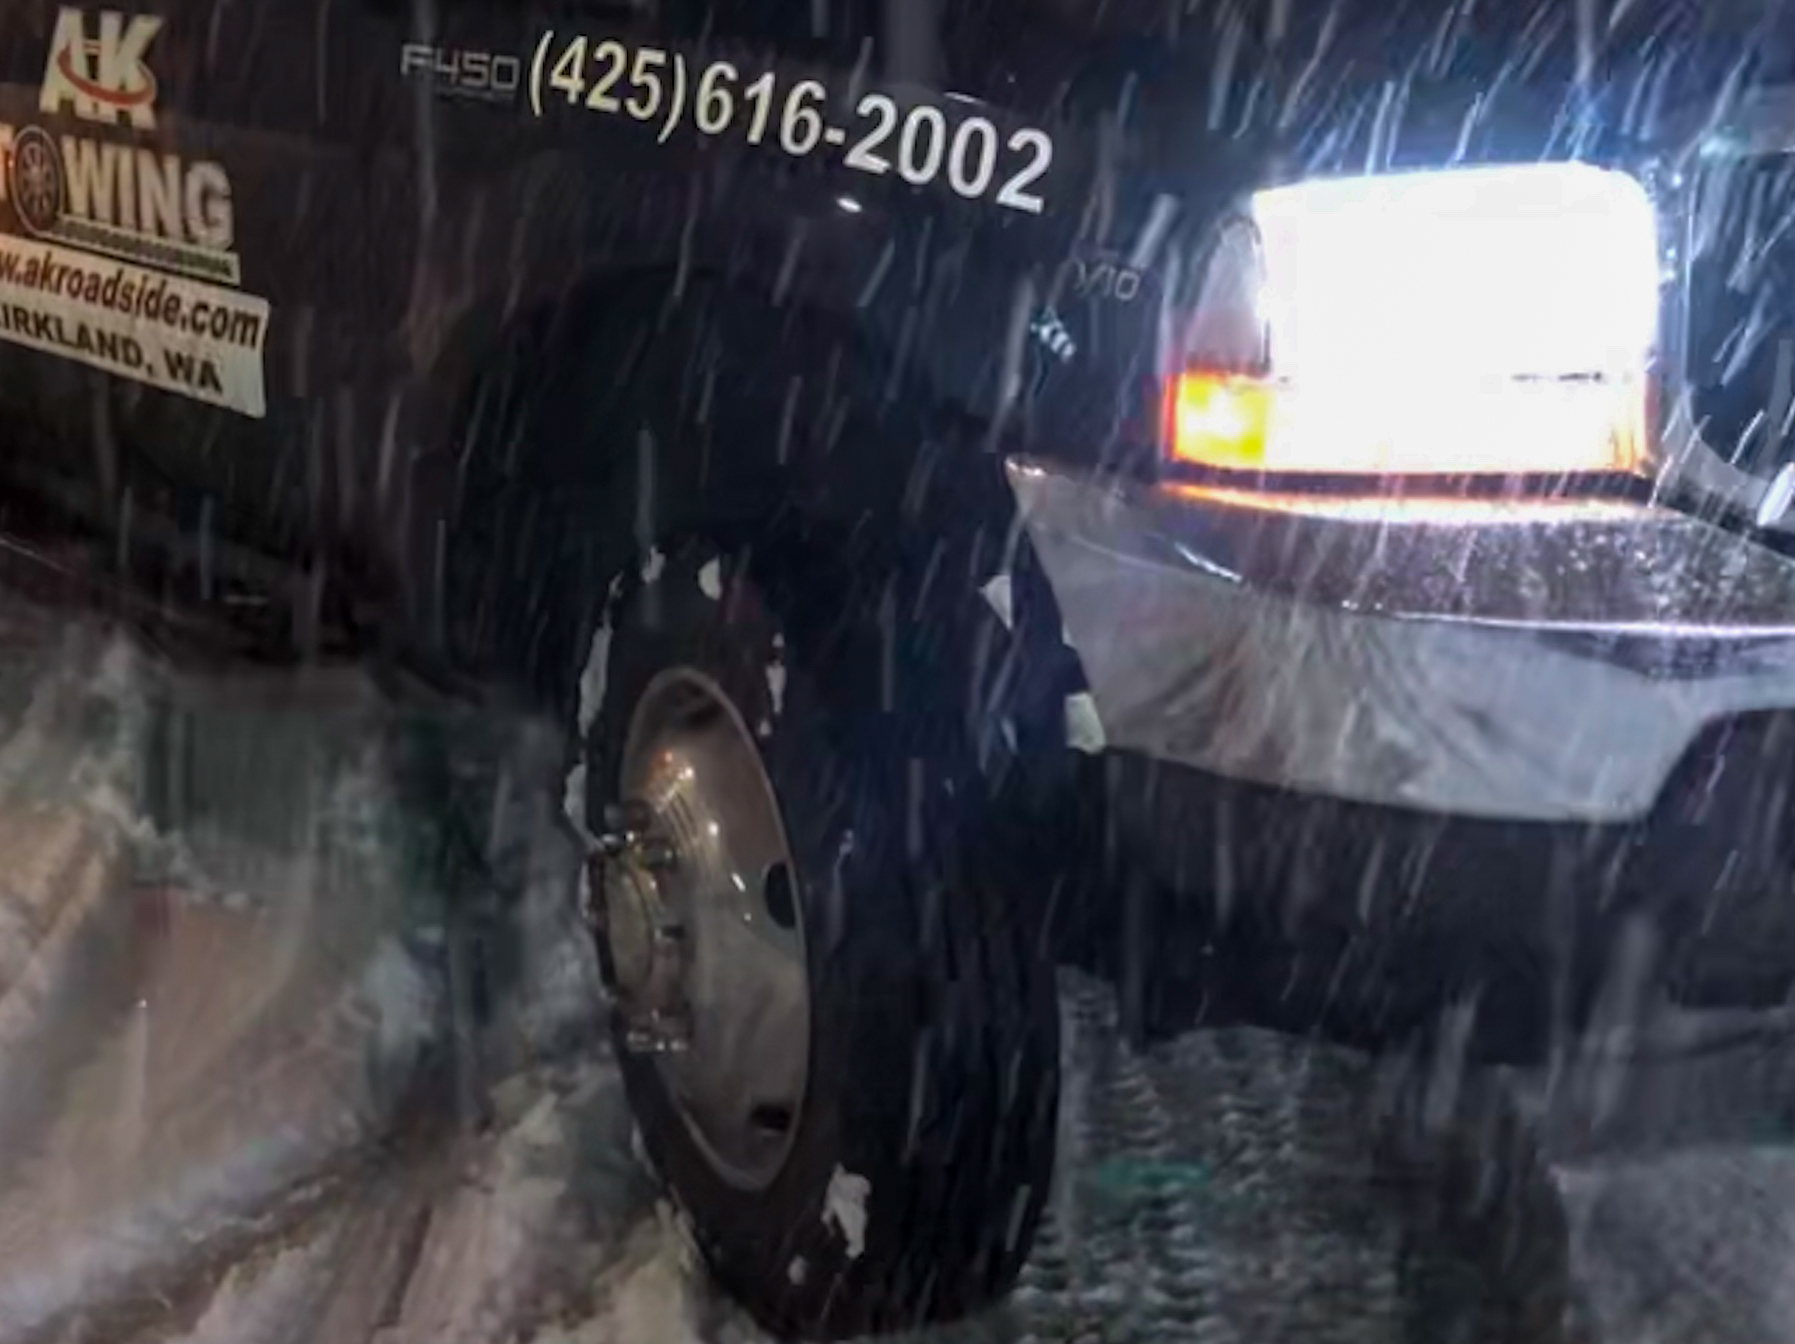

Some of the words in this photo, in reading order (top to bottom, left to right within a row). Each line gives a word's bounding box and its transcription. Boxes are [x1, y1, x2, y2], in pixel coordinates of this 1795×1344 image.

[39, 6, 164, 130] AK
[400, 44, 520, 88] F450
[163, 349, 223, 394] WA
